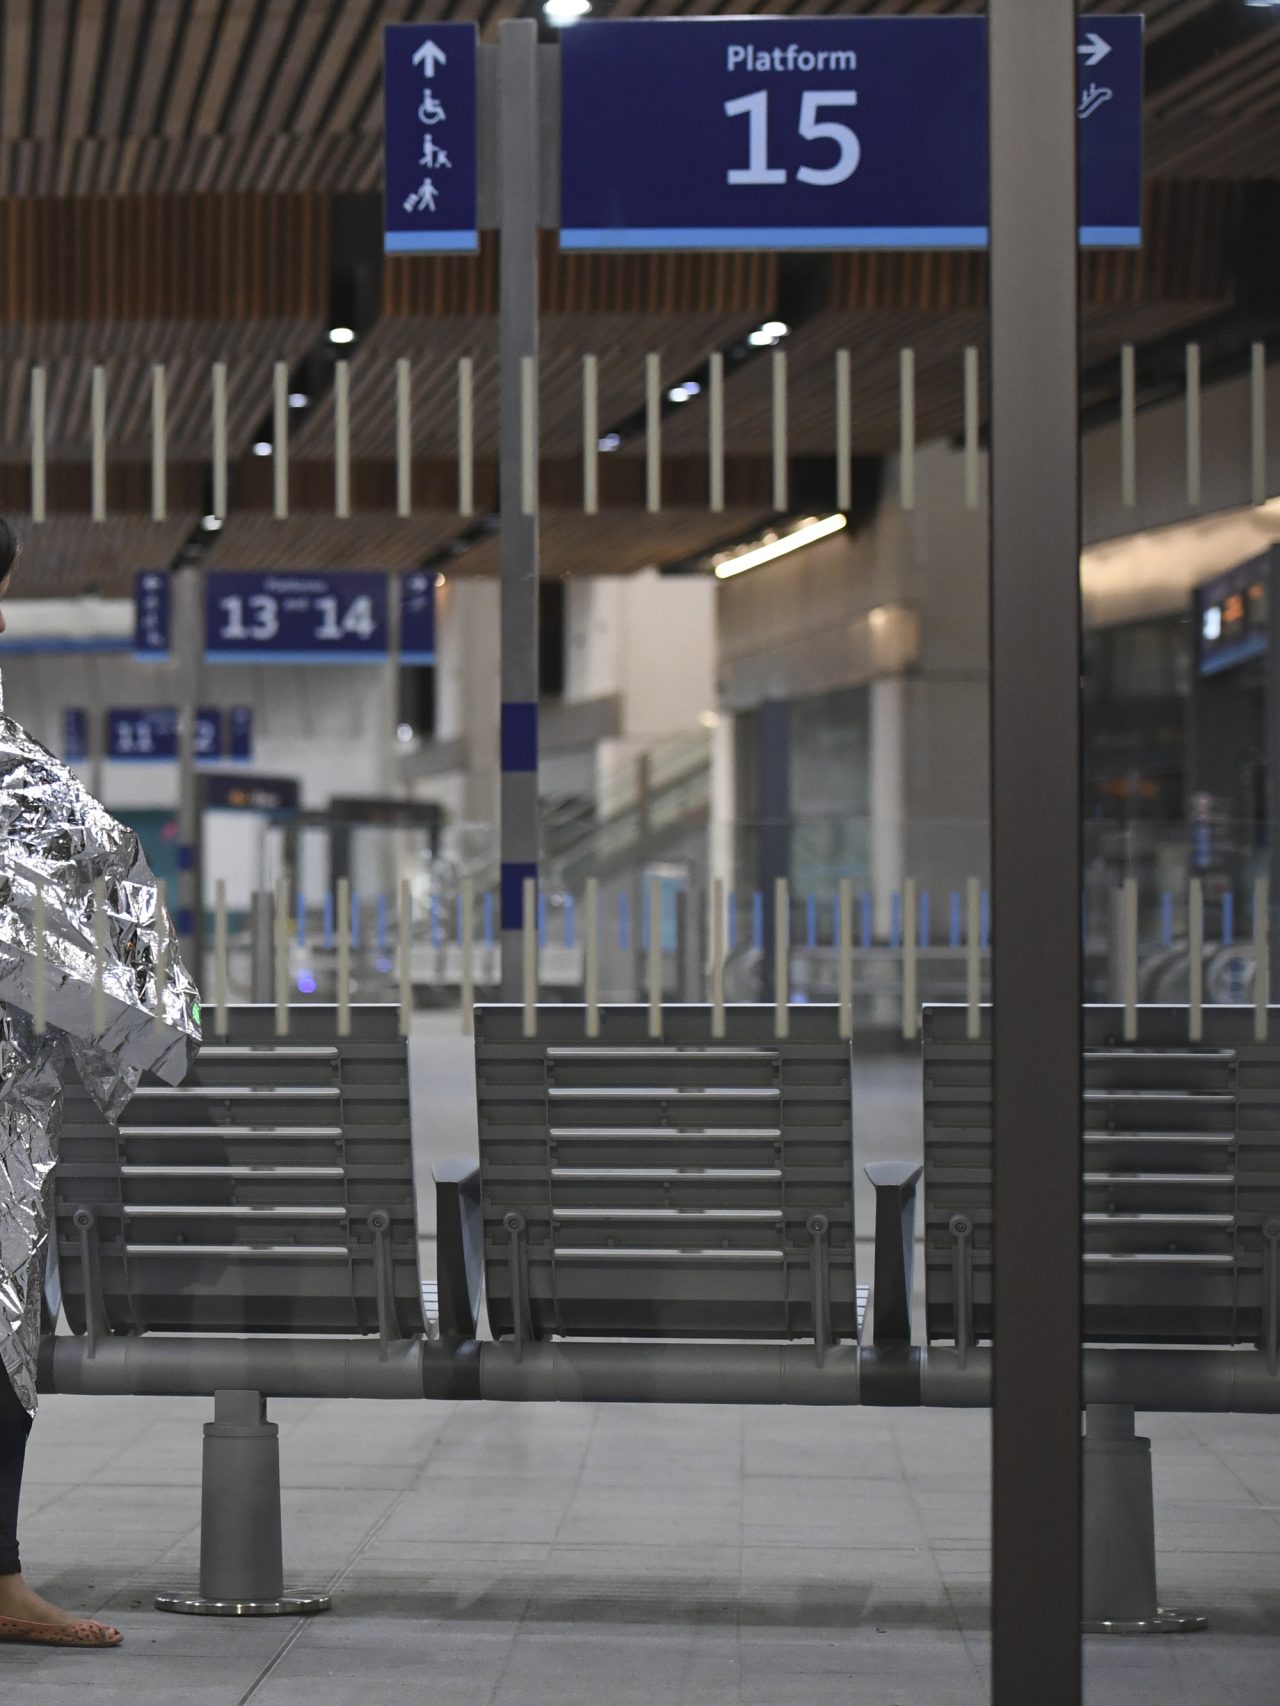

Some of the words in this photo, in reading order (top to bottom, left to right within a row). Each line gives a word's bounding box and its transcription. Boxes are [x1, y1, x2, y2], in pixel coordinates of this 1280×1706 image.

[727, 44, 857, 72] Platform
[724, 89, 861, 186] 15
[220, 593, 279, 640] 13
[314, 594, 377, 640] 14
